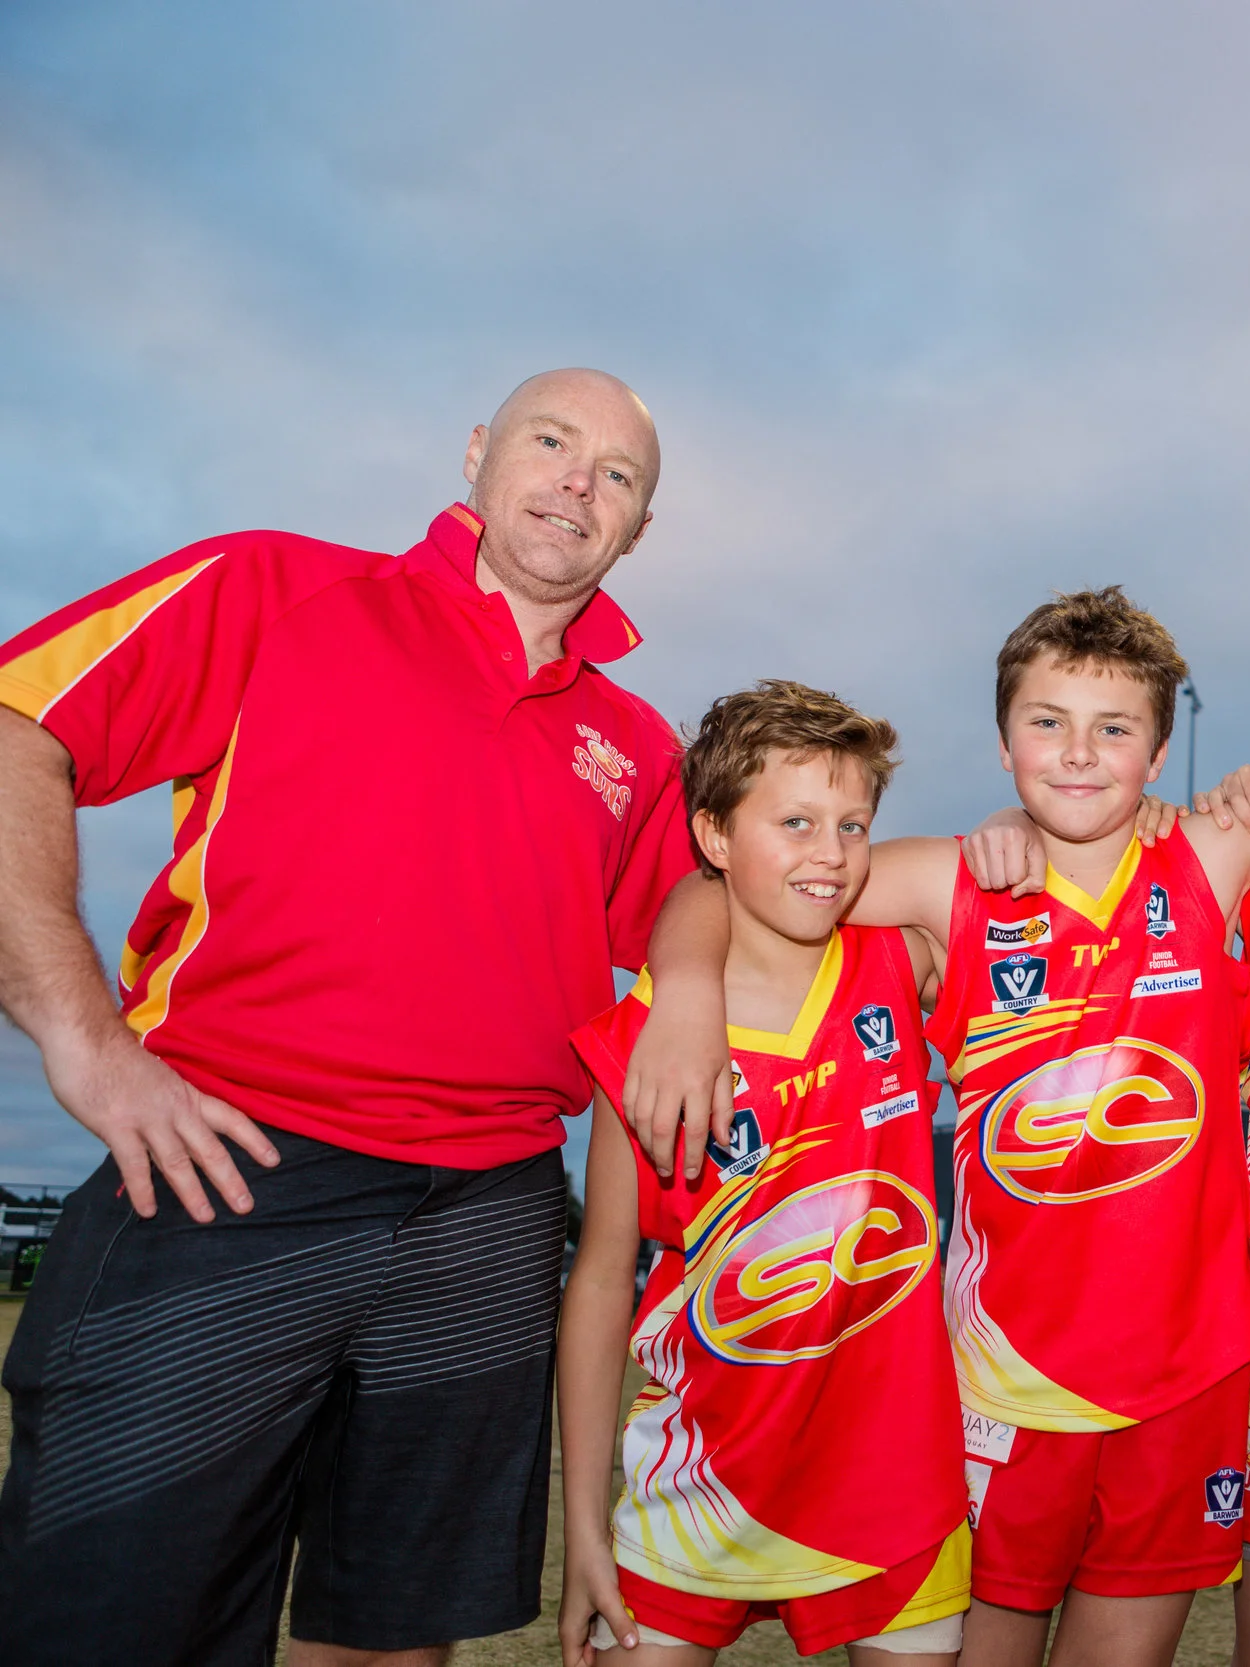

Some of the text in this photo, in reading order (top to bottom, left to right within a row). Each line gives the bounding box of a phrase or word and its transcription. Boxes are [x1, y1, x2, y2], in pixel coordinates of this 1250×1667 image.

[572, 745, 632, 821] SUNS
[1009, 955, 1029, 963] AFL
[1149, 959, 1179, 969] FOOTBALL
[1152, 951, 1173, 961] JUNIOR
[1141, 976, 1200, 993] Advertiser
[1003, 997, 1038, 1010] COUNTRY
[773, 1060, 837, 1107] TWP
[876, 1099, 916, 1121] Advertiser
[992, 1075, 1200, 1171] SC
[729, 1151, 762, 1175] COUNTRY
[711, 1207, 935, 1344] SC
[961, 1413, 1010, 1442] UAY2
[1218, 1468, 1235, 1477] AFL
[1213, 1510, 1239, 1520] BARWON
